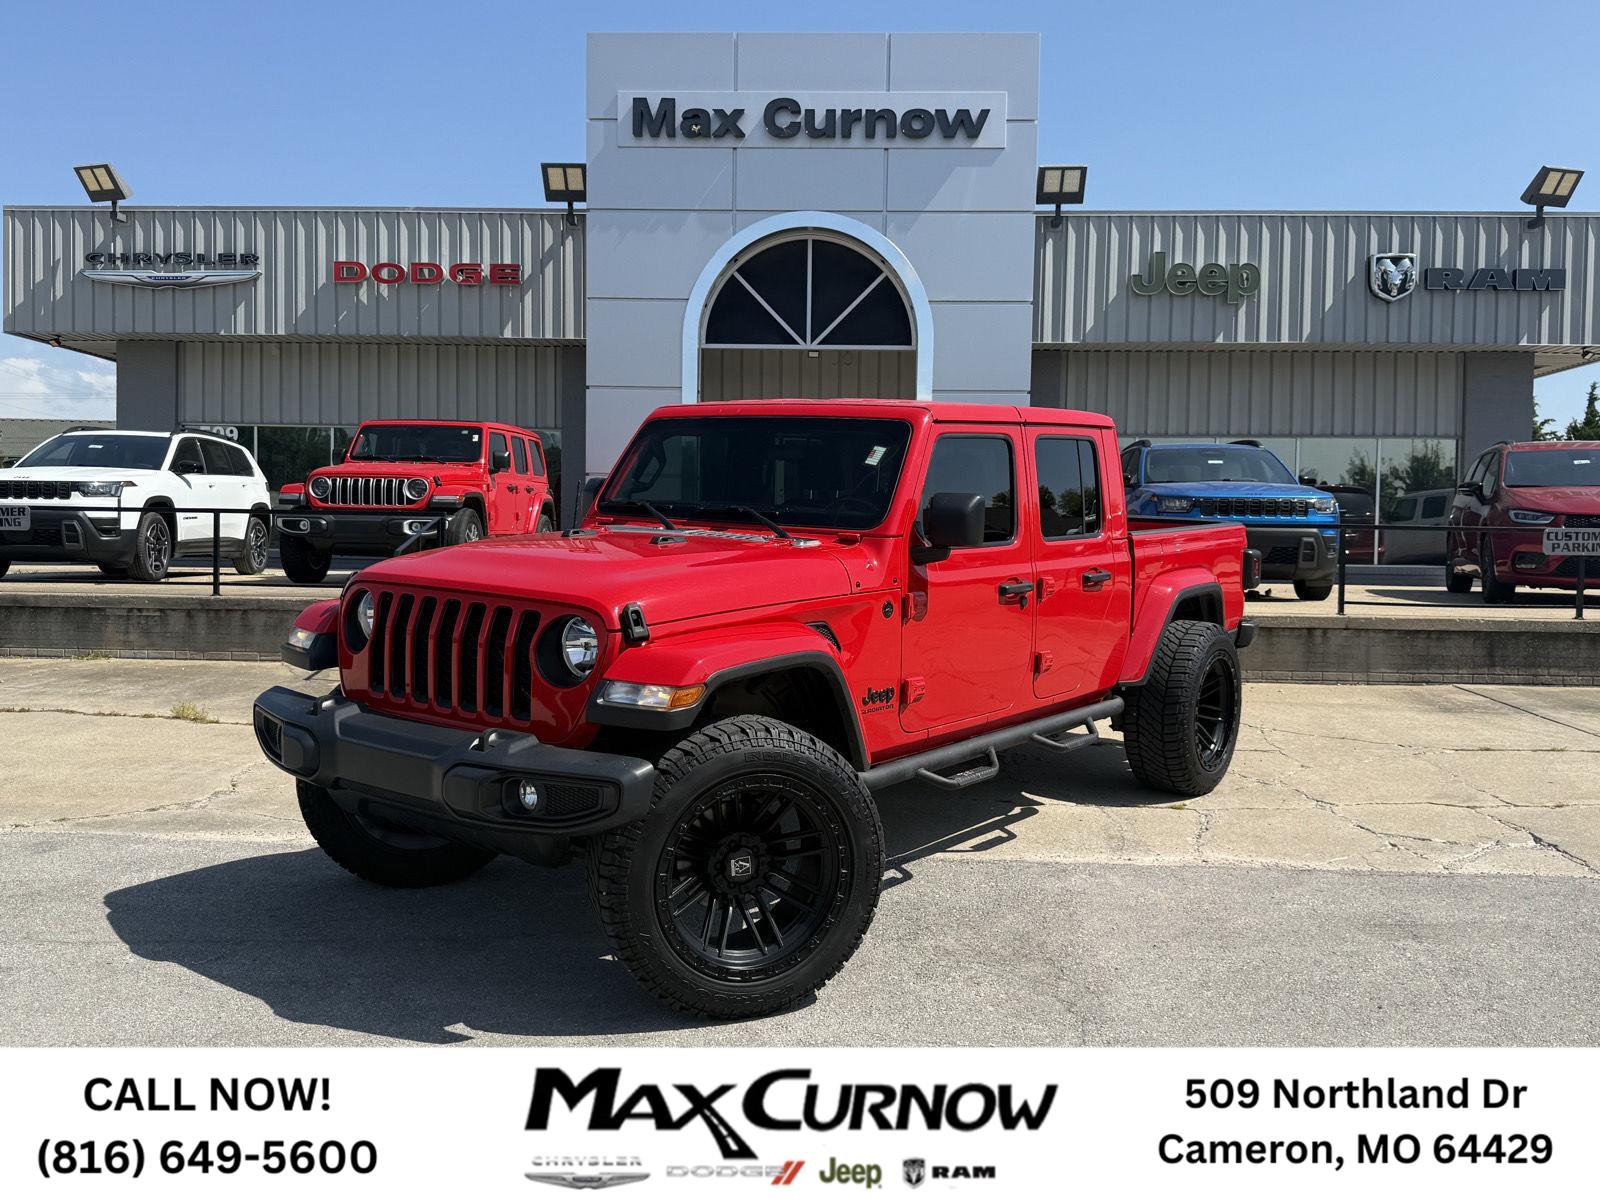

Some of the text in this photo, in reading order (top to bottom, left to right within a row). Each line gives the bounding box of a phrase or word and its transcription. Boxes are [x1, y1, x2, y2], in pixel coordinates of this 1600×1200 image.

[632, 97, 991, 140] Max Curnow
[85, 252, 260, 266] CHRYSLER
[333, 260, 523, 286] DODGE
[1130, 251, 1261, 304] Jeep
[1424, 267, 1567, 291] RAM
[862, 686, 896, 706] Jeep
